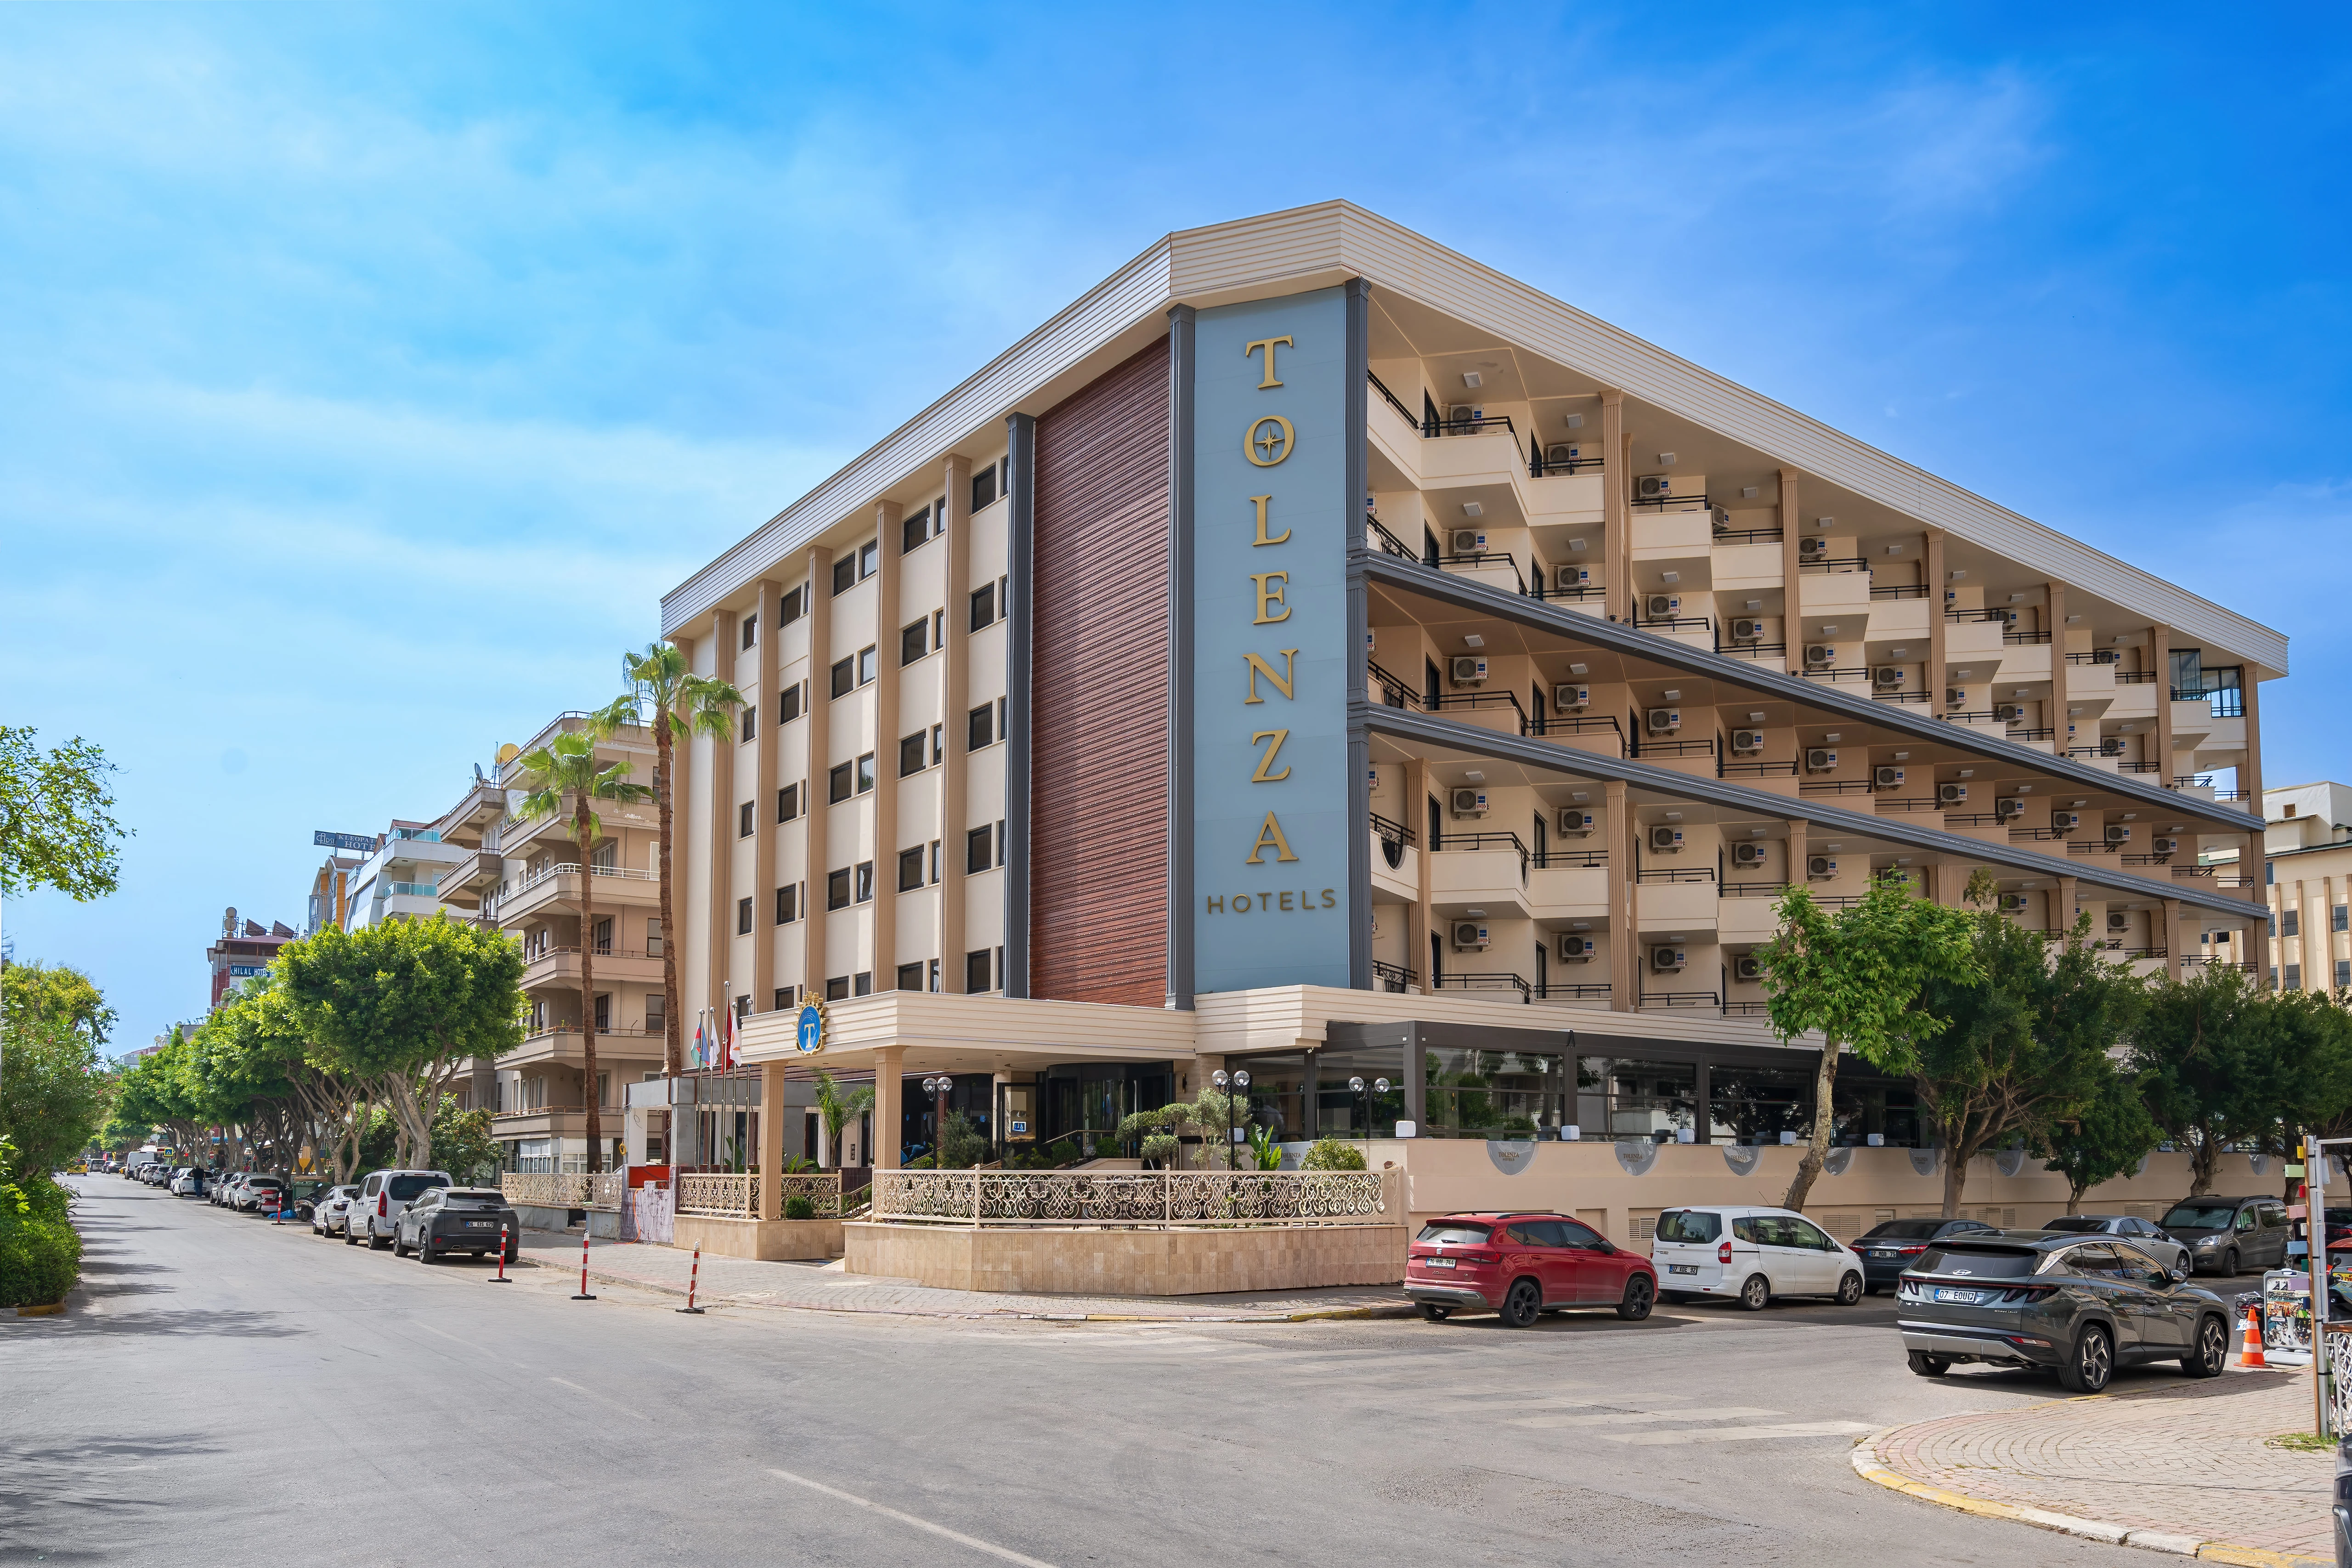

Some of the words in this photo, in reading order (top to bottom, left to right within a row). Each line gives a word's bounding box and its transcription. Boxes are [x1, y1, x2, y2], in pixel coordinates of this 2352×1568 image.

[1243, 335, 1298, 863] TOLENZA
[339, 834, 377, 843] KLEOPAT
[1208, 889, 1335, 914] HOTELS
